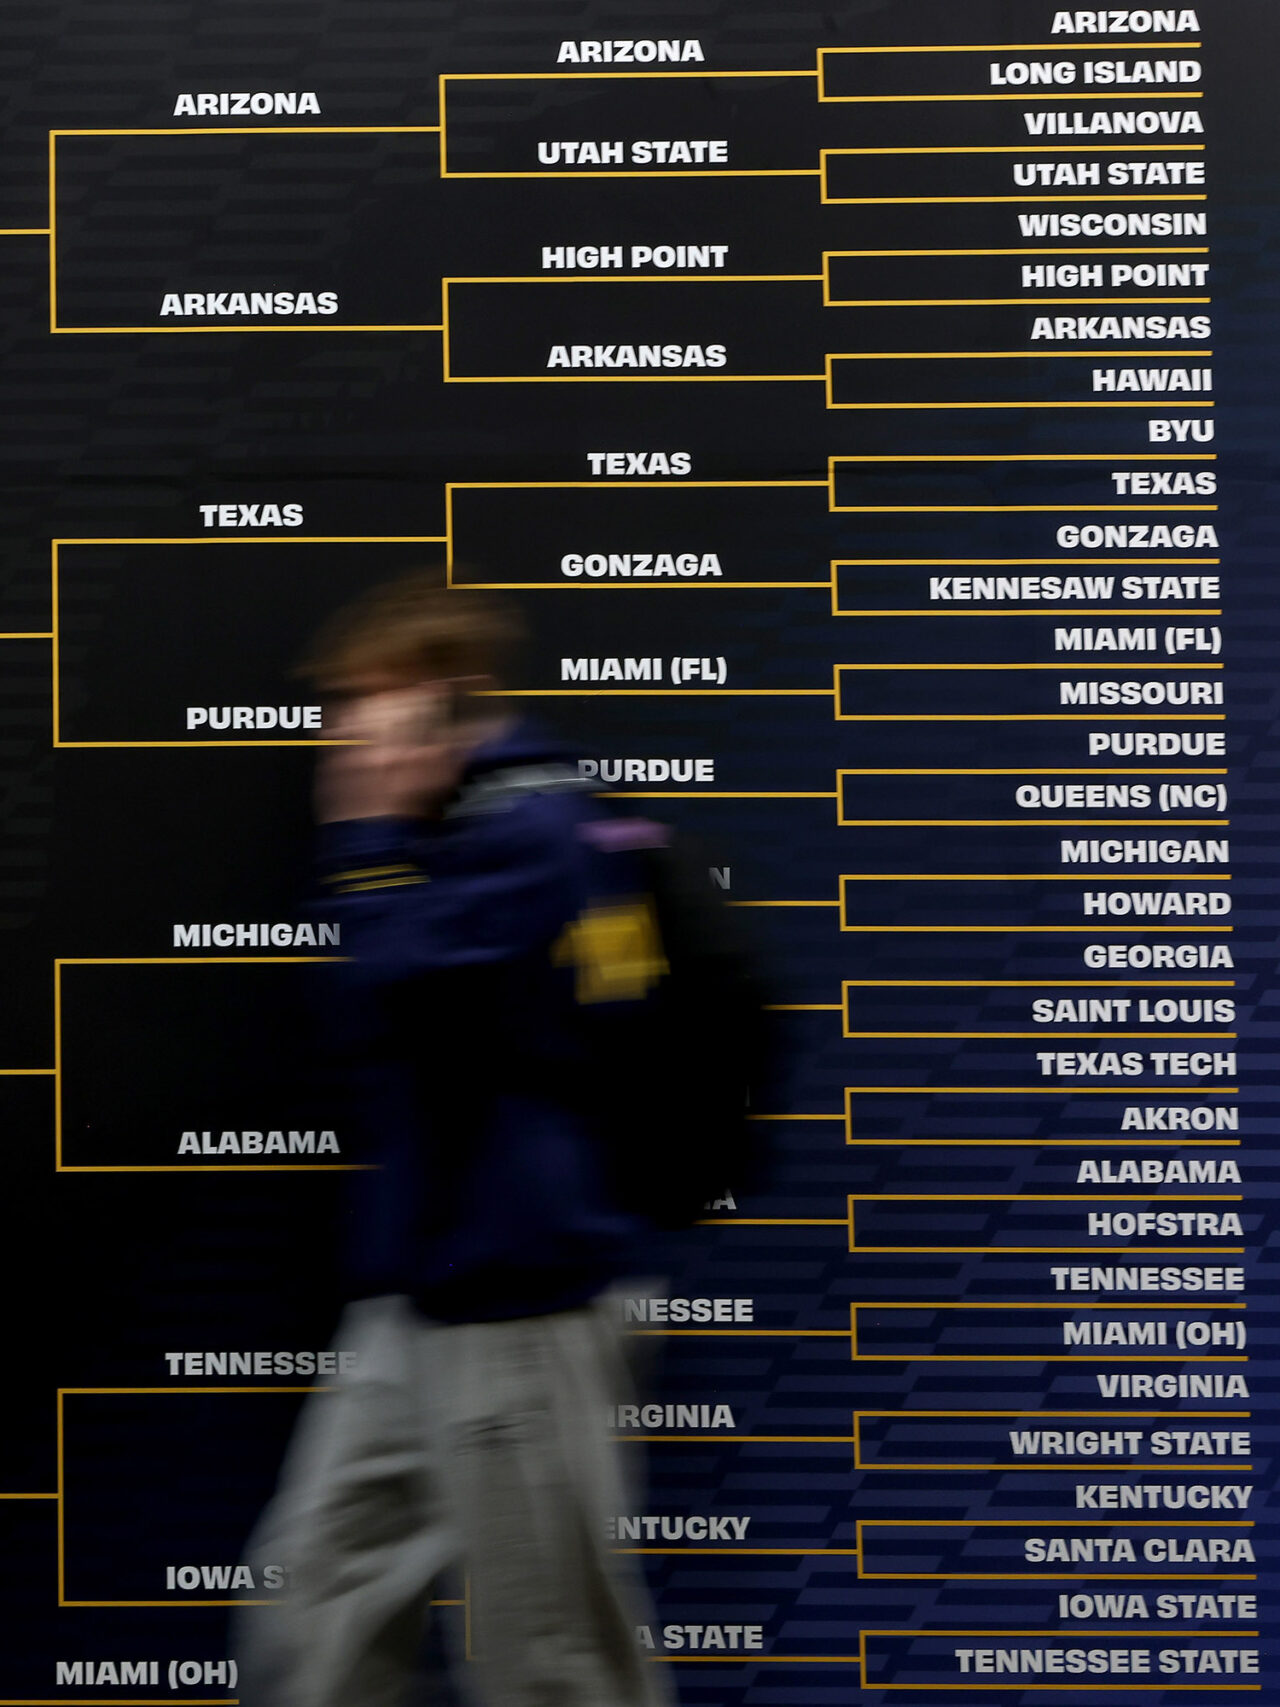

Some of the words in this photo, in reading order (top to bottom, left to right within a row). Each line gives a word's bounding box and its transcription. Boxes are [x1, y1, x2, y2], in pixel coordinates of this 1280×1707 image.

[1050, 9, 1201, 34] ARIZONA
[556, 39, 705, 63] ARIZONA
[990, 60, 1077, 86] LONG
[1083, 60, 1202, 86] ISLAND
[173, 92, 321, 117] ARIZONA
[1023, 110, 1205, 135] VILLANOVA
[537, 140, 624, 165] UTAH
[631, 140, 728, 165] STATE
[1013, 161, 1101, 187] UTAH
[1107, 161, 1206, 187] STATE
[1017, 212, 1207, 237] WISCONSIN
[541, 245, 624, 269] HIGH
[630, 245, 729, 269] POINT
[1021, 263, 1104, 288] HIGH
[1110, 263, 1210, 288] POINT
[159, 291, 339, 316] ARKANSAS
[1030, 315, 1212, 340] ARKANSAS
[546, 344, 727, 368] ARKANSAS
[1092, 368, 1213, 392] HAWAII
[1148, 419, 1215, 443] BYU
[586, 452, 692, 475] TEXAS
[1111, 471, 1217, 495] TEXAS
[199, 503, 304, 527] TEXAS
[1056, 524, 1220, 549] GONZAGA
[560, 553, 723, 577] GONZAGA
[929, 576, 1116, 600] KENNESAW
[1121, 576, 1221, 600] STATE
[1054, 626, 1157, 651] MIAMI
[1164, 626, 1222, 655] (FL)
[561, 656, 663, 681] MIAMI
[670, 656, 727, 685] (FL)
[1059, 681, 1224, 705] MISSOURI
[186, 706, 322, 730] PURDUE
[1088, 732, 1226, 756] PURDUE
[577, 758, 715, 783] PURDUE
[1015, 783, 1152, 808] QUEENS
[1158, 783, 1228, 812] (NC)
[1060, 839, 1230, 864] MICHIGAN
[1083, 892, 1232, 916] HOWARD
[172, 922, 341, 948] MICHIGAN
[1083, 944, 1235, 969] GEORGIA
[1032, 999, 1132, 1023] SAINT
[1138, 999, 1236, 1023] LOUIS
[1036, 1052, 1144, 1076] TEXAS
[1149, 1052, 1237, 1076] TECH
[1120, 1106, 1239, 1131] AKRON
[177, 1131, 340, 1155] ALABAMA
[1076, 1160, 1242, 1184] ALABAMA
[1088, 1212, 1244, 1237] HOFSTRA
[1050, 1267, 1245, 1291] TENNESSEE
[624, 1298, 754, 1323] NESSEE
[1063, 1320, 1168, 1346] MIAMI
[1175, 1320, 1247, 1350] (OH)
[164, 1351, 358, 1376] TENNESSEE
[1096, 1374, 1250, 1398] VIRGINIA
[1009, 1431, 1144, 1455] WRIGHT
[1150, 1431, 1251, 1455] STATE
[1075, 1485, 1253, 1509] KENTUCKY
[605, 1516, 751, 1541] ENTUCKY
[1024, 1538, 1137, 1563] SANTA
[1143, 1538, 1256, 1563] CLARA
[166, 1565, 256, 1590] IOWA
[1059, 1594, 1150, 1619] IOWA
[1156, 1594, 1257, 1619] STATE
[663, 1625, 763, 1649] STATE
[954, 1649, 1151, 1674] TENNESSEE
[1158, 1649, 1259, 1674] STATE
[56, 1660, 159, 1686] MIAMI
[168, 1659, 238, 1690] (OH)
